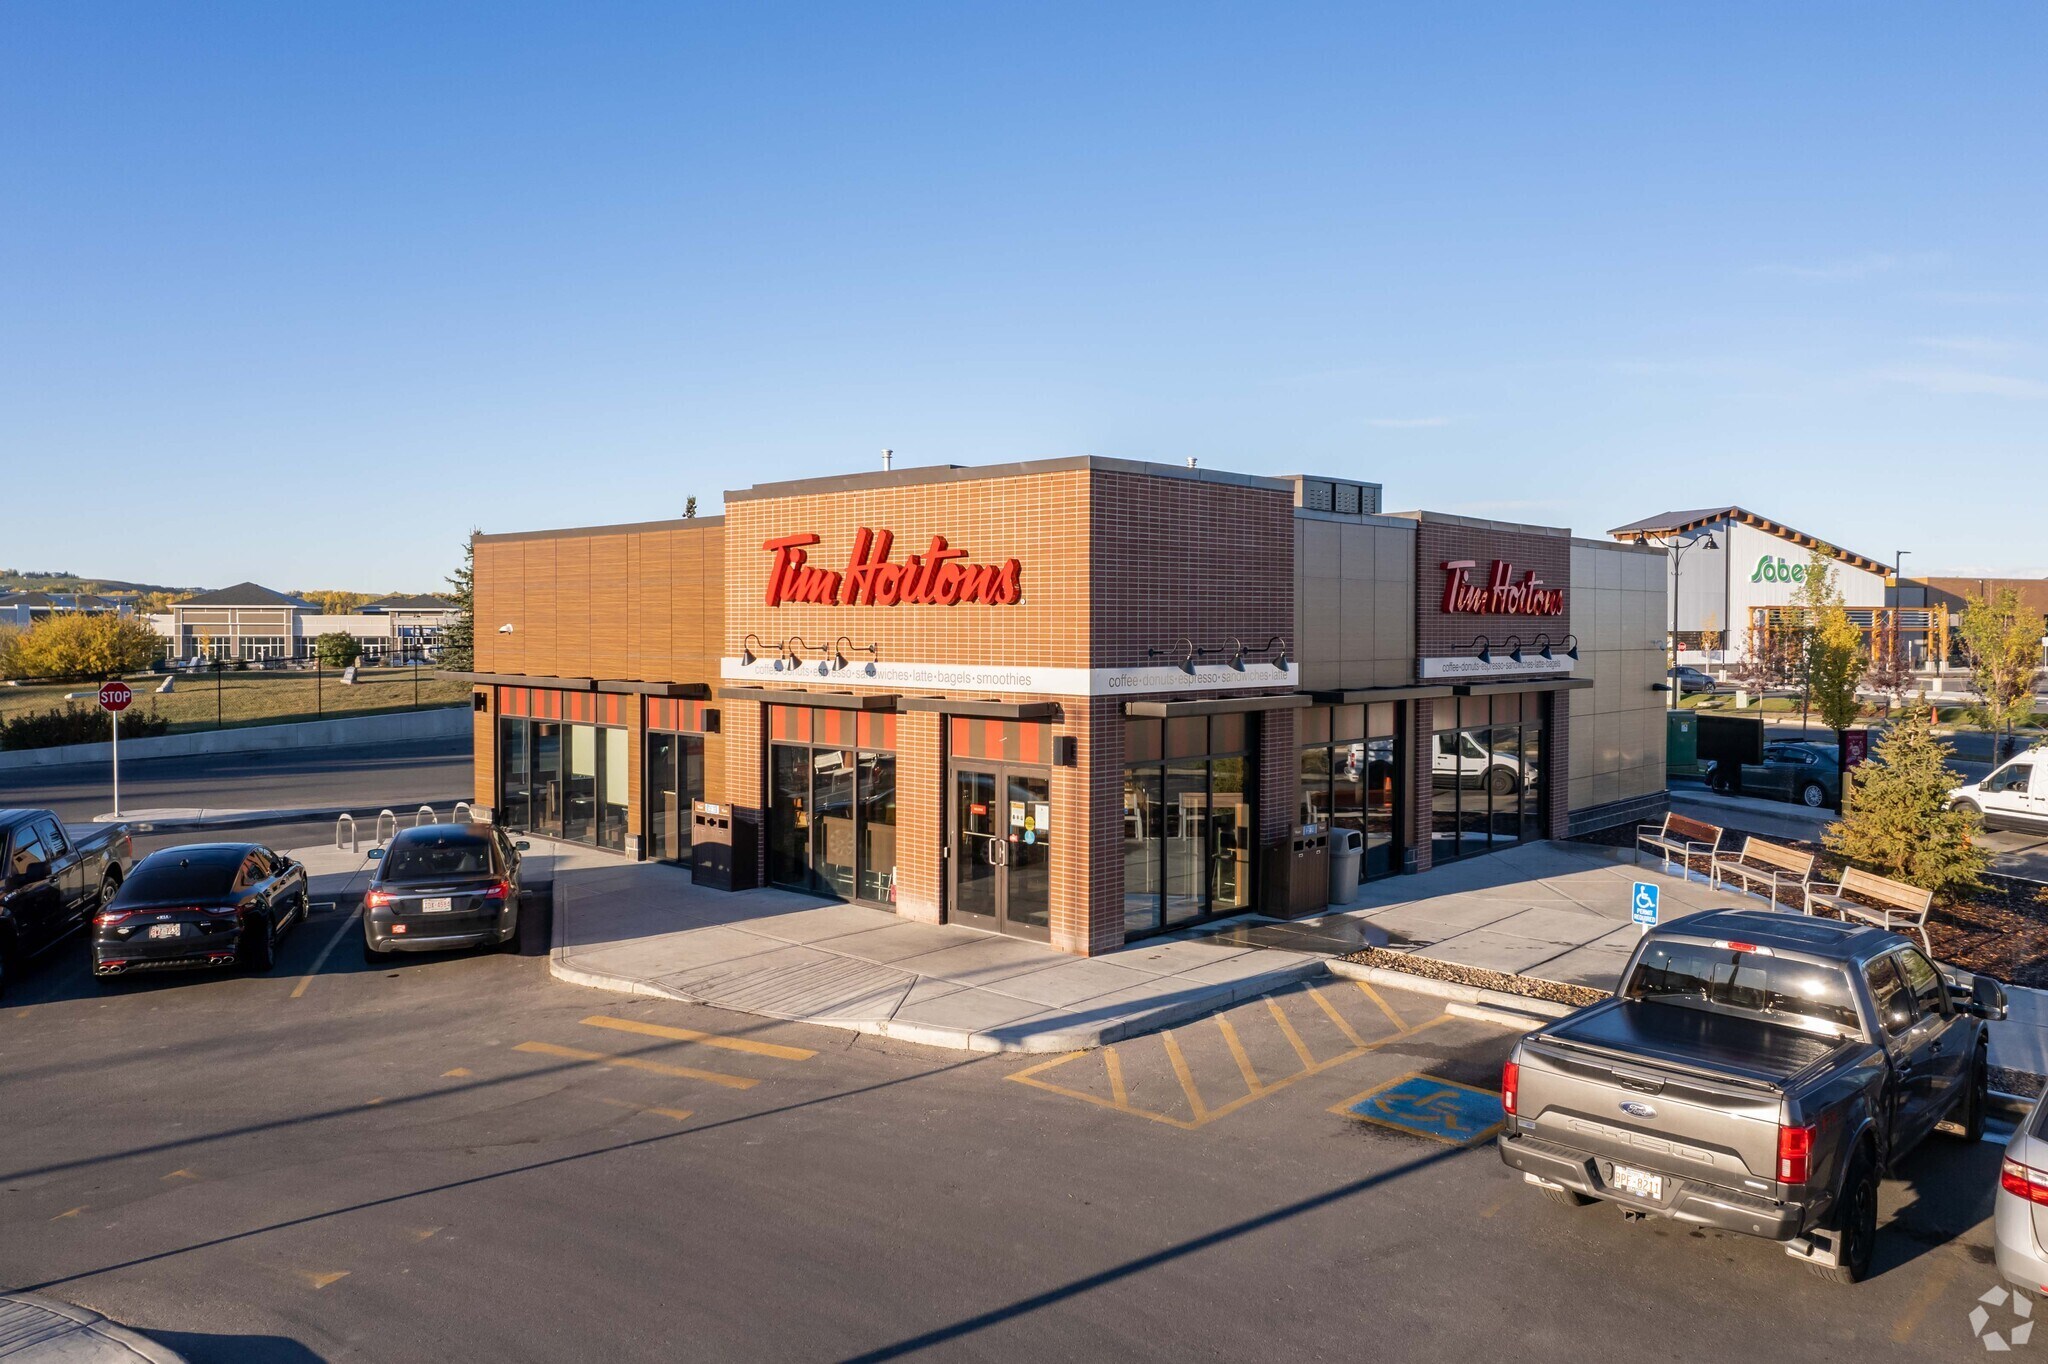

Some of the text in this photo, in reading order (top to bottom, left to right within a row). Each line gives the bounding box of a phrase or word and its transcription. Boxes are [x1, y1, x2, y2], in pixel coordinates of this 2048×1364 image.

[762, 526, 1022, 608] Tim Hortons
[1750, 554, 1828, 583] Sobe
[1440, 559, 1563, 616] Tim Hortons
[913, 669, 933, 682] latte
[938, 670, 971, 686] bagels
[976, 672, 1032, 687] smoothies
[1108, 674, 1138, 688] coffee
[1142, 673, 1175, 687] donuts
[1178, 671, 1218, 687] espresso
[1221, 669, 1269, 684] sandwiches
[100, 691, 131, 703] STOP
[1566, 1119, 1715, 1166] F-150
